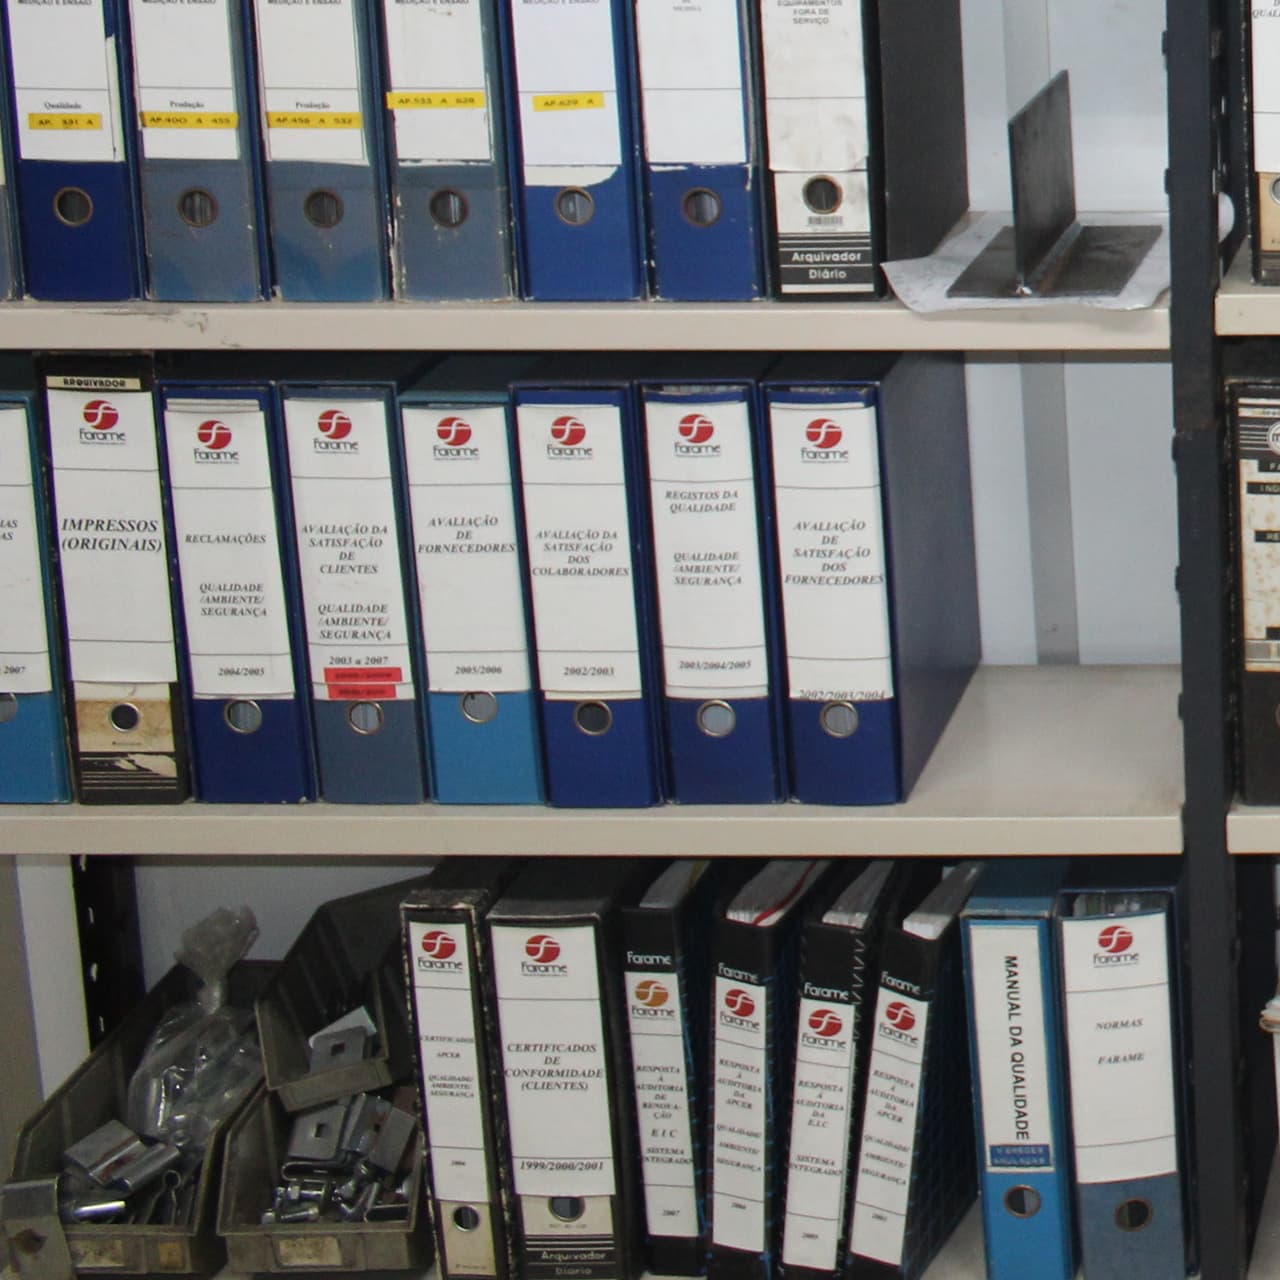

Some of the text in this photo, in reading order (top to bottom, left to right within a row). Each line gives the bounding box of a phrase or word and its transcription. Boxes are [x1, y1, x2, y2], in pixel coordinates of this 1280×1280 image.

[792, 251, 862, 263] Arquivador
[808, 268, 847, 280] Diário
[61, 518, 158, 532] IMPRESSOS
[61, 537, 163, 552] (ORIGINAIS)
[185, 533, 266, 544] RECLAMAÇÕES
[319, 564, 378, 574] CLIENTES
[531, 566, 630, 578] COLABORADORES
[784, 574, 885, 586] FORNECEDORES
[1096, 1018, 1143, 1030] NORMAS
[506, 1043, 597, 1053] CERTIFICADOS
[1004, 955, 1030, 1140] MANUAL DA QUALIDADE
[543, 1056, 561, 1065] DE
[1097, 1053, 1144, 1065] FARAME
[504, 1068, 604, 1078] CONFORMIDADE
[521, 1081, 589, 1091] (CLIENTES)
